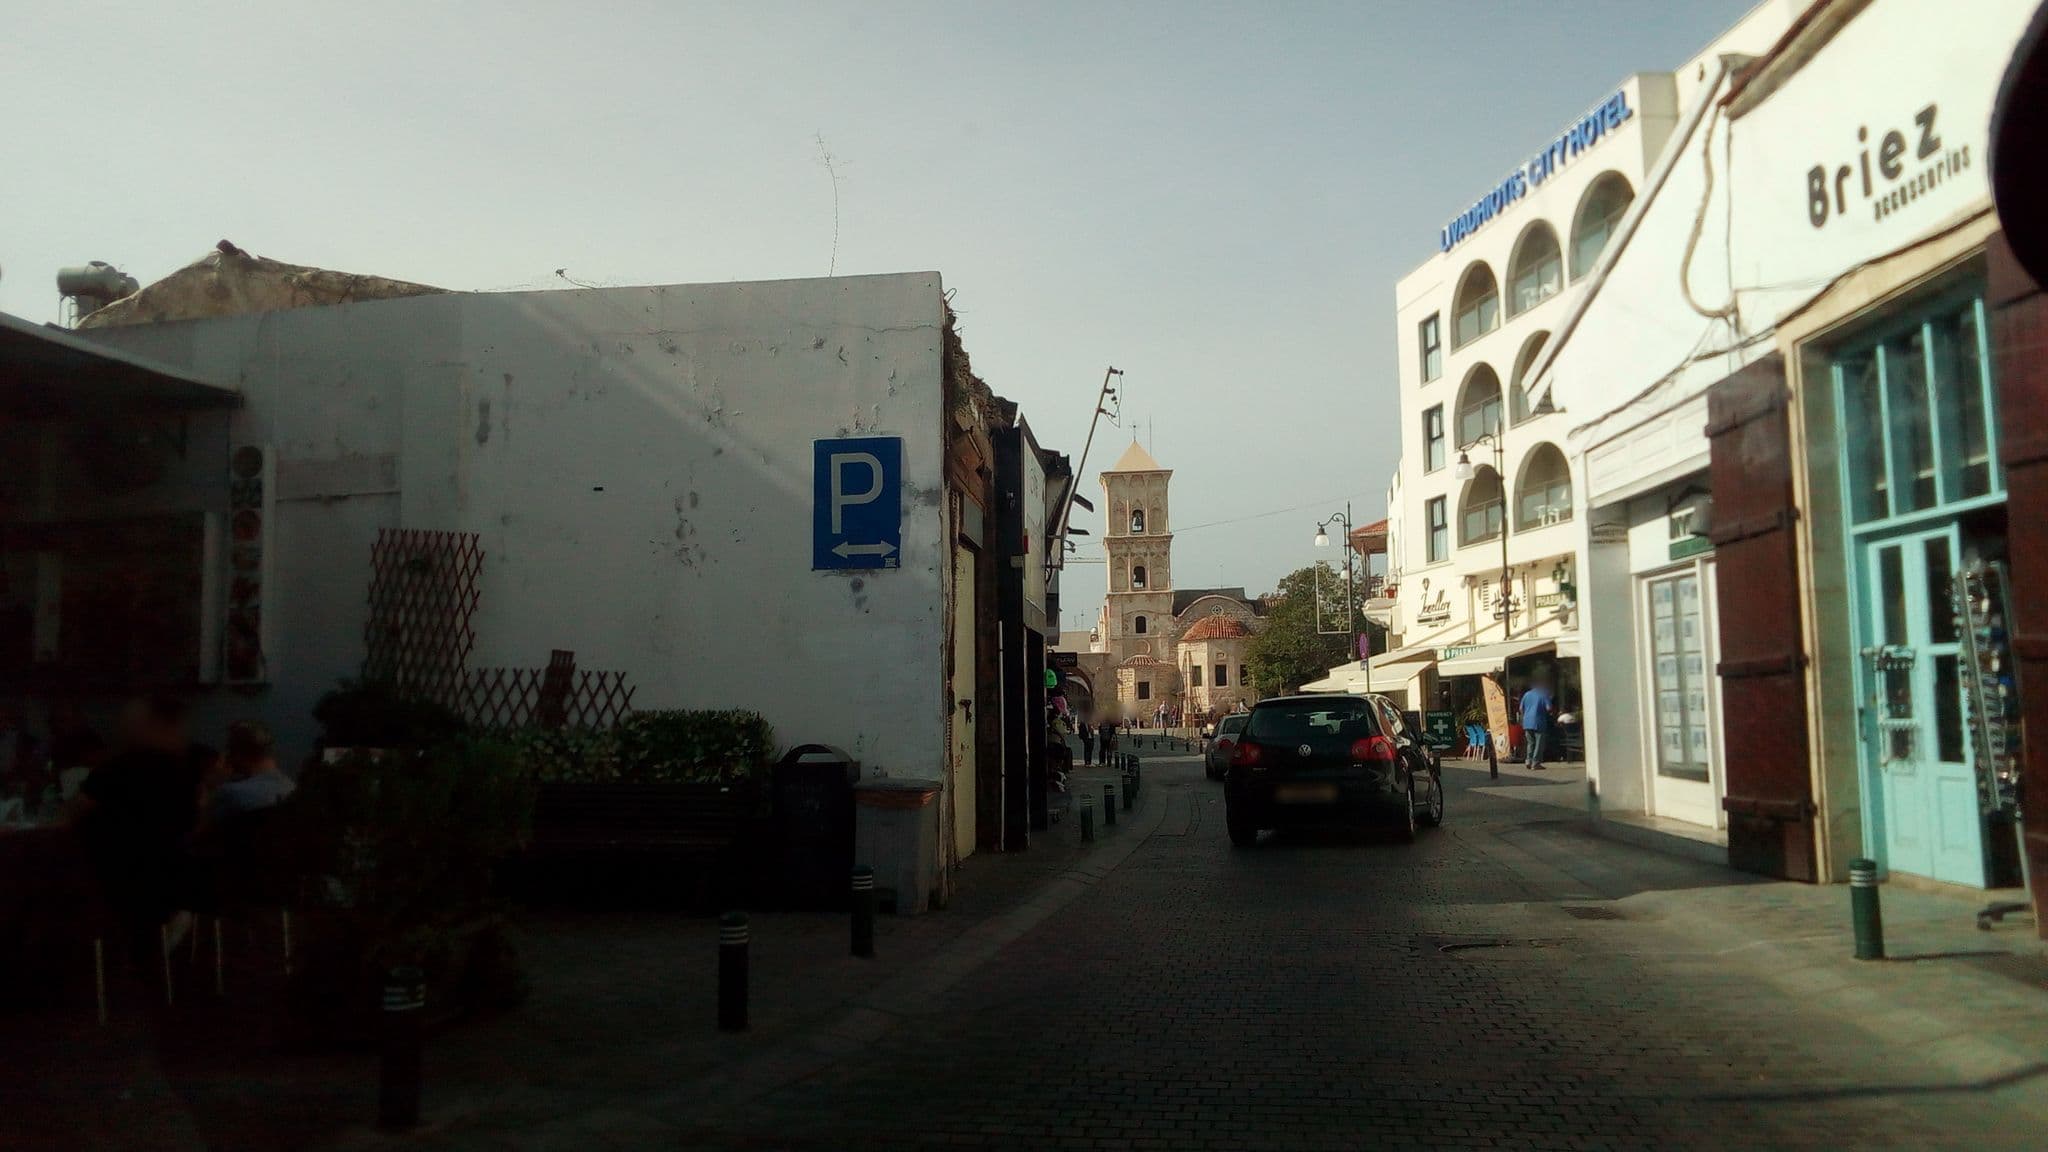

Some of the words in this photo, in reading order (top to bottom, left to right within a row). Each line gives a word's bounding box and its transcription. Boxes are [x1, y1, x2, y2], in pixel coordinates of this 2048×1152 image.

[1440, 170, 1526, 252] LIVADHIOTIS
[1529, 135, 1568, 186] CITY
[1570, 90, 1633, 156] HOTEL
[1808, 104, 1941, 228] Briez
[831, 452, 884, 534] P
